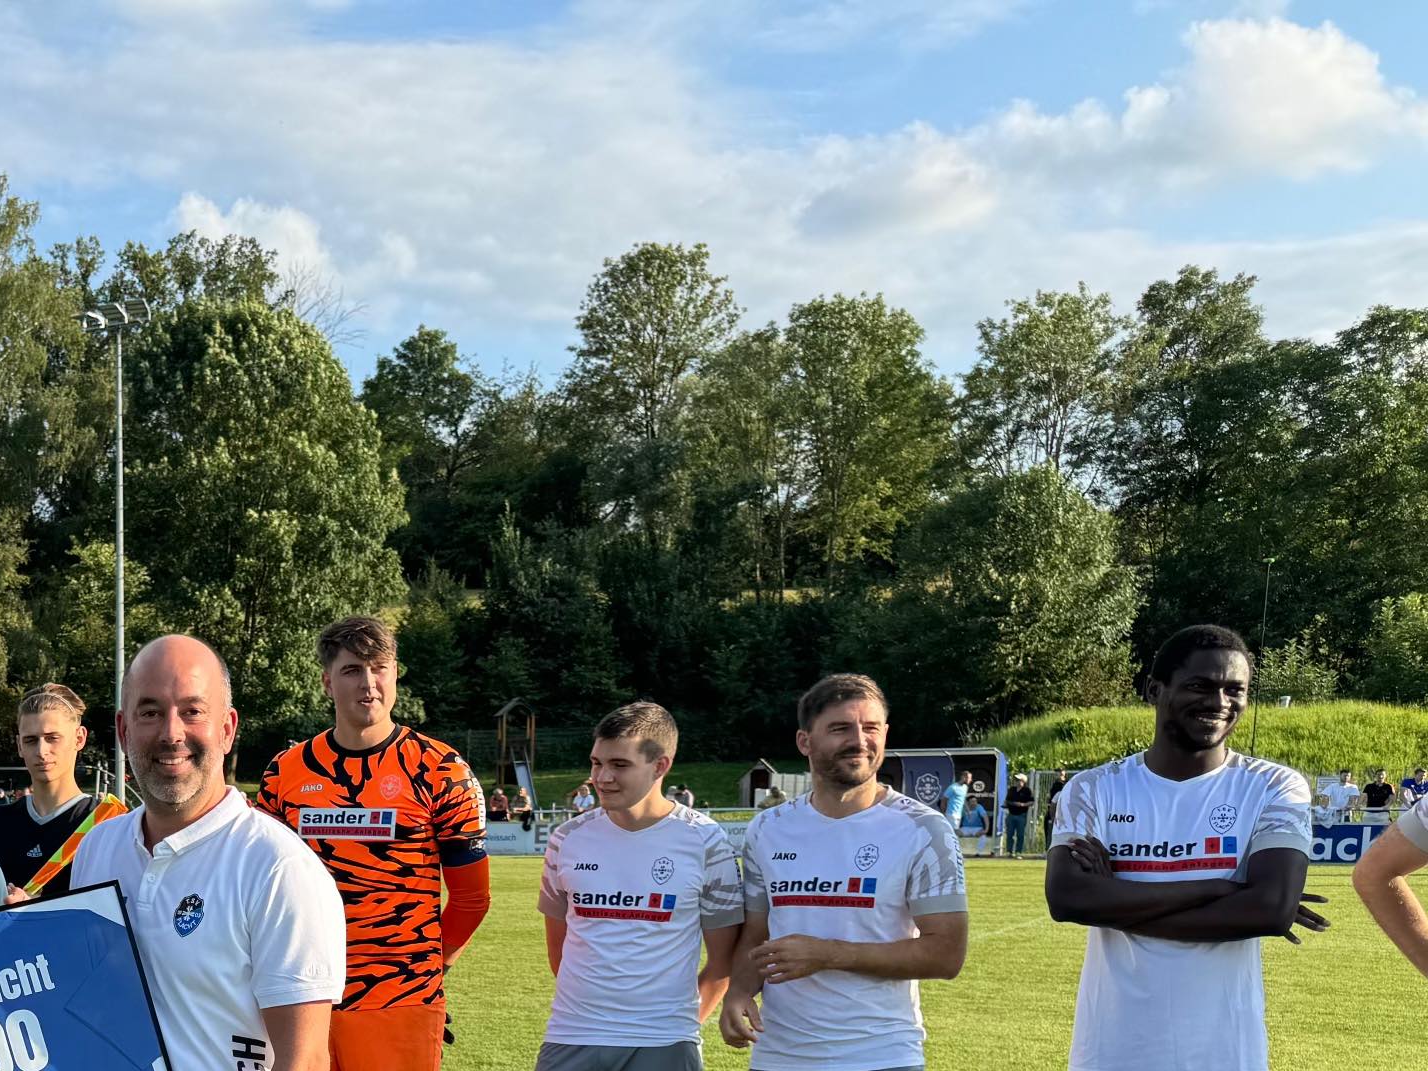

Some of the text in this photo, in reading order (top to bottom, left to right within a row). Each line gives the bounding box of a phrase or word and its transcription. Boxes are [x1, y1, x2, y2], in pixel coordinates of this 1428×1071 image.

[300, 784, 323, 793] JAKO
[302, 811, 366, 825] sander
[771, 852, 798, 861] JAKO
[1109, 842, 1198, 858] sander
[573, 863, 599, 871] JAKO
[770, 877, 843, 894] sander
[573, 891, 644, 907] sander
